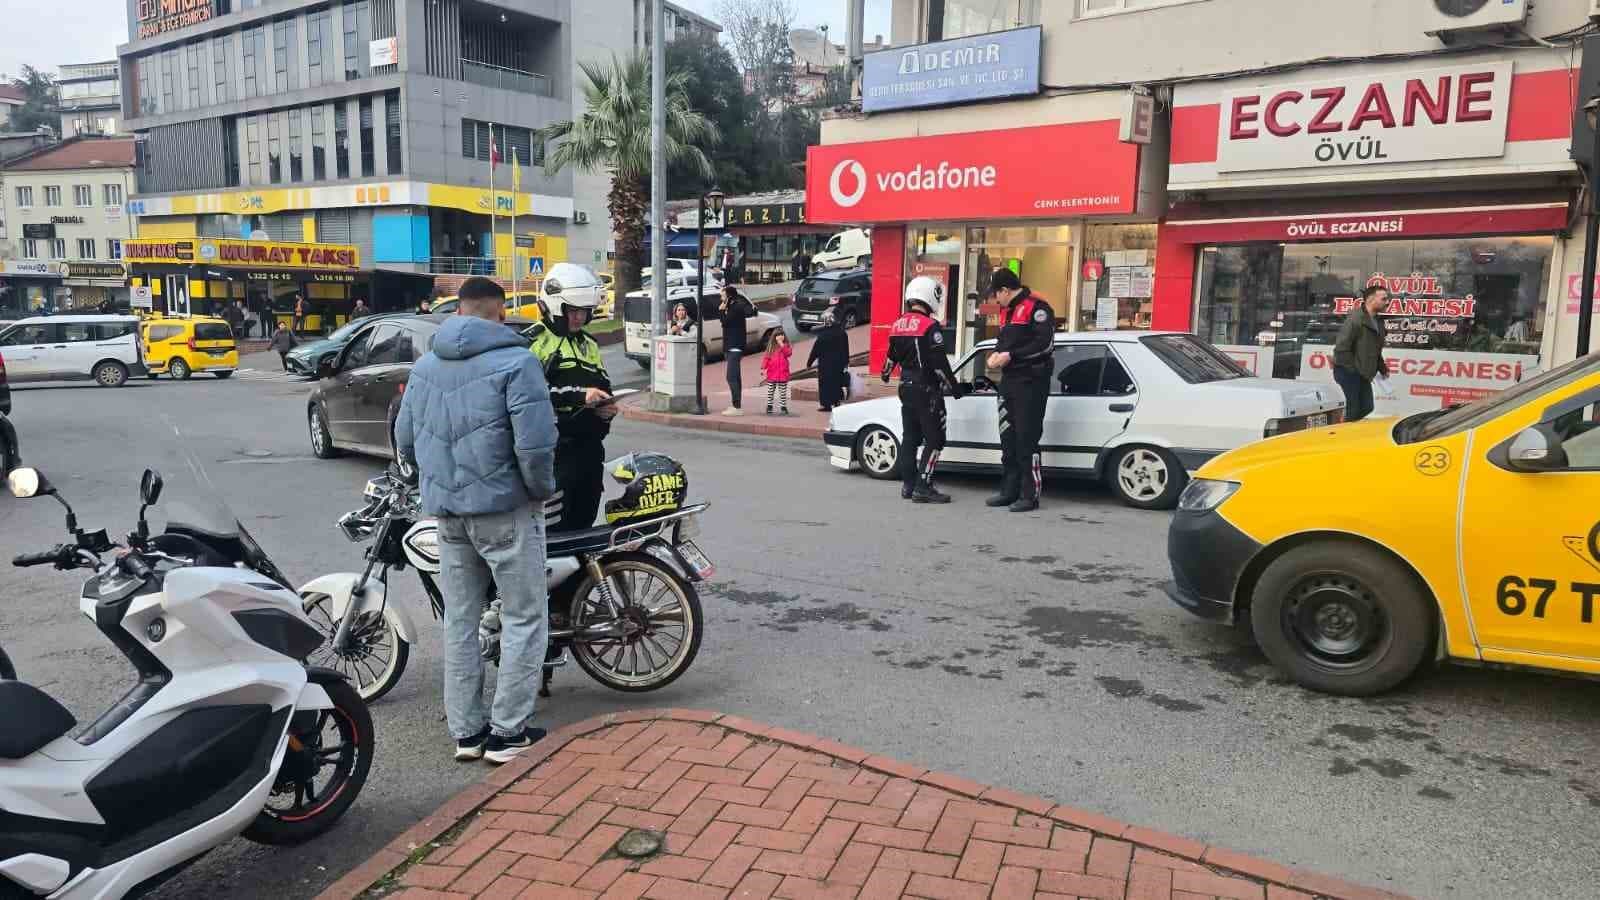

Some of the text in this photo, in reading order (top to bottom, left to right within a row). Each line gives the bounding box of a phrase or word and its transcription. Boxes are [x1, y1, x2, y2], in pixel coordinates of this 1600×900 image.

[1229, 71, 1495, 141] ECZANE
[1134, 101, 1150, 137] E
[1314, 136, 1388, 162] ÖVÜL
[876, 161, 997, 192] vodafone
[1033, 199, 1060, 209] CENK
[1286, 217, 1404, 237] ÖVÜL ECZANESİ
[219, 244, 294, 263] MURAT
[1366, 272, 1442, 295] ÖVÜL
[1334, 294, 1476, 318] EANESİ
[1384, 358, 1523, 382] ECZANESİ
[1417, 452, 1448, 469] 23
[639, 490, 675, 509] OVER
[1496, 575, 1557, 619] 67
